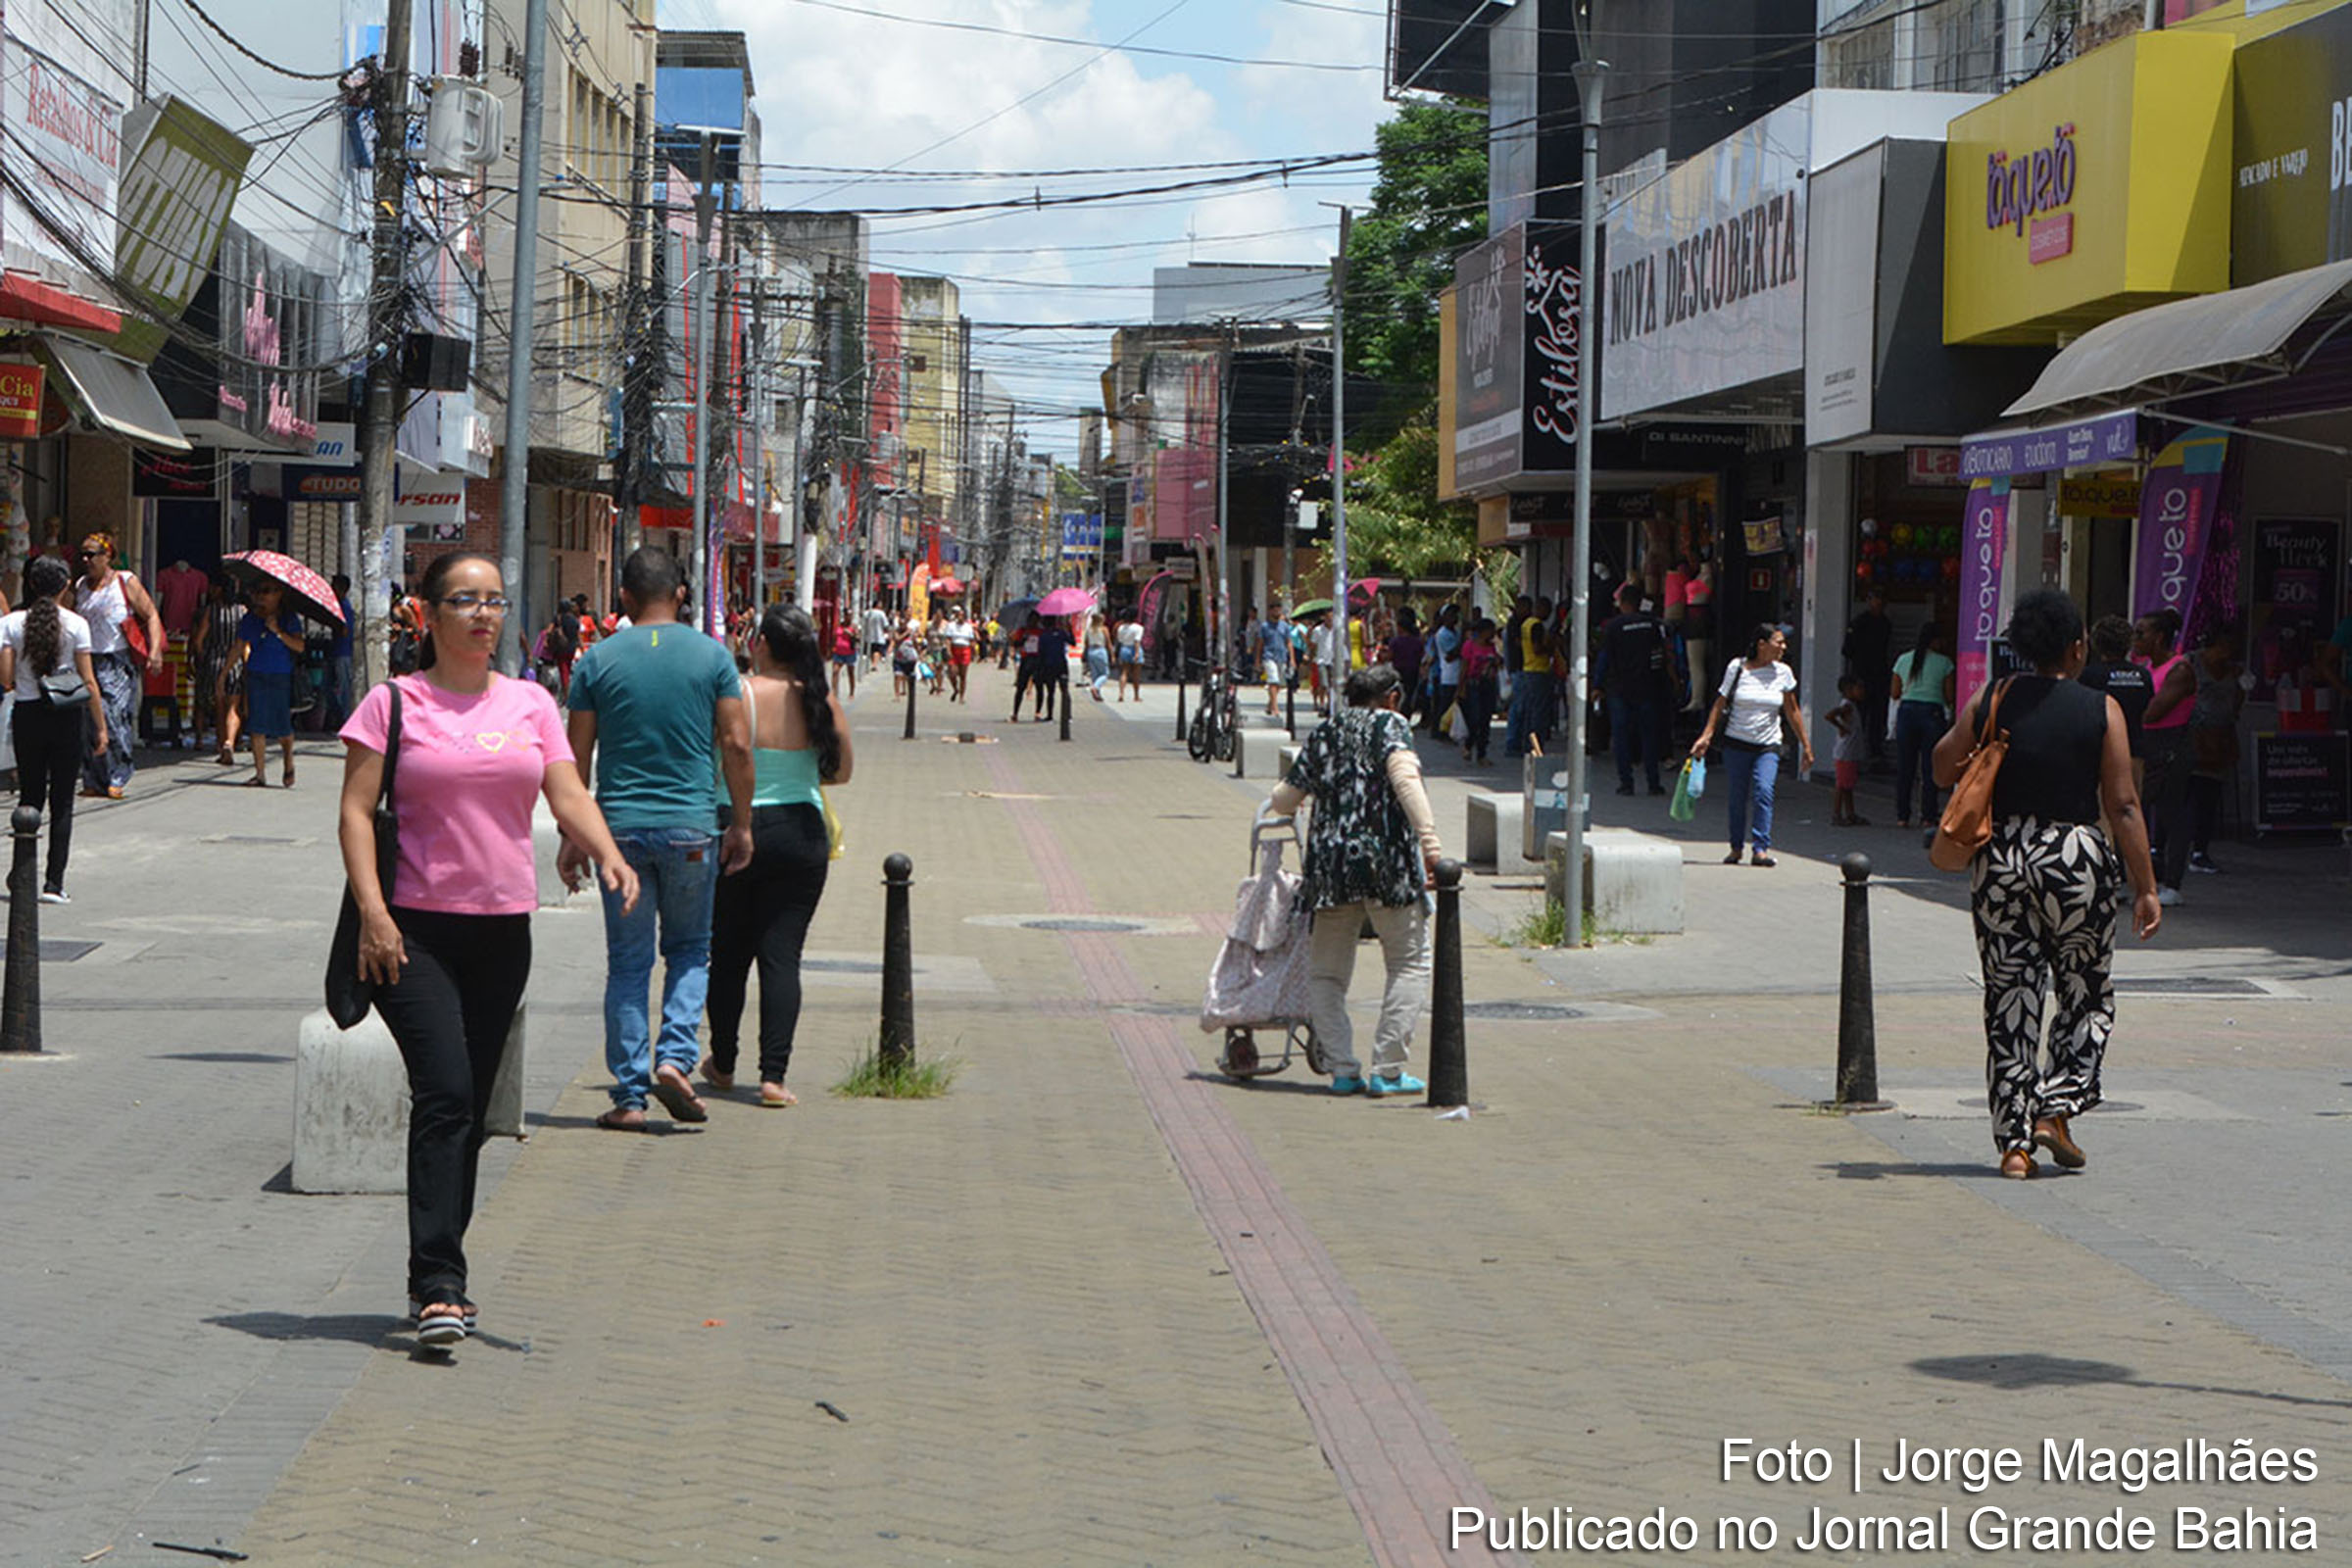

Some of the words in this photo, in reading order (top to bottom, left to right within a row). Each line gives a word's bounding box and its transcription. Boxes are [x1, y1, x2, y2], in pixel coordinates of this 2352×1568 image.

[1610, 253, 1657, 346] NOVA
[1664, 189, 1796, 327] DESCOBERTA
[0, 375, 35, 397] Cia
[1534, 264, 1583, 445] Estilosa
